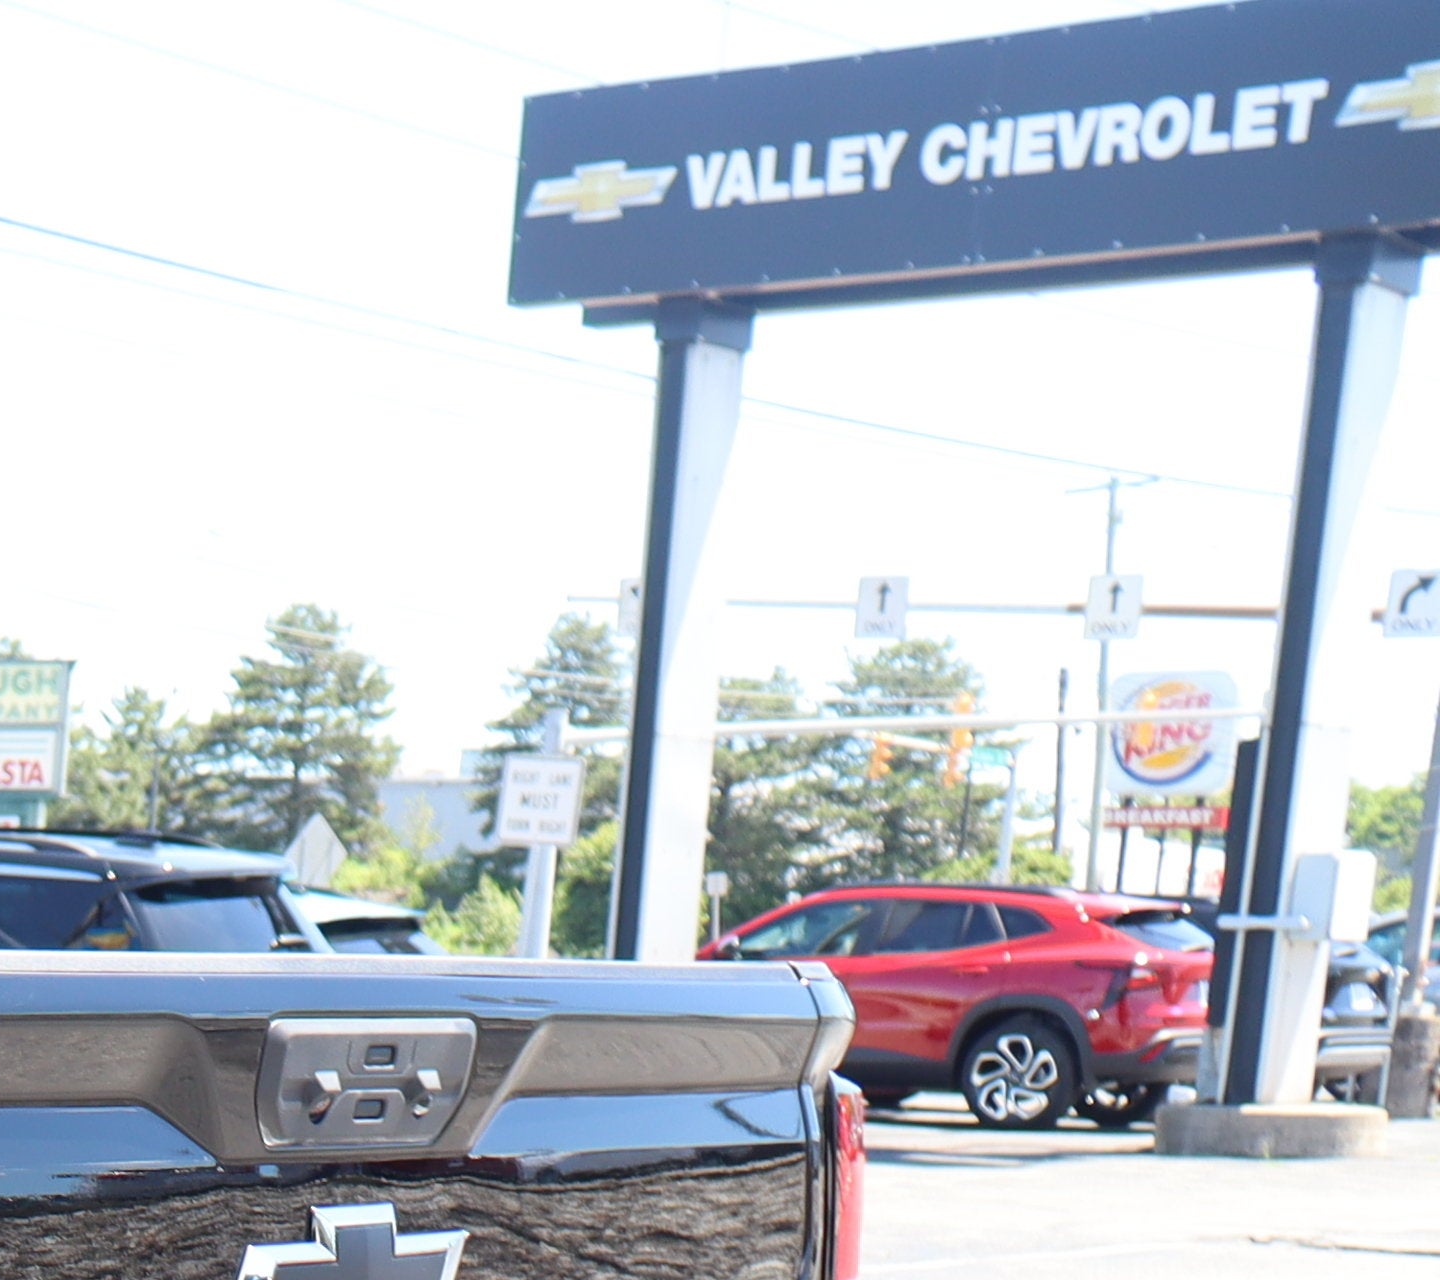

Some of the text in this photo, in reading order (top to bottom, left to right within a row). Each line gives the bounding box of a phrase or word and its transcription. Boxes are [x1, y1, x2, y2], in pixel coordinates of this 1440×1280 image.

[686, 78, 1328, 209] VALLEY CHEVROLET
[1090, 619, 1130, 635] ONLY
